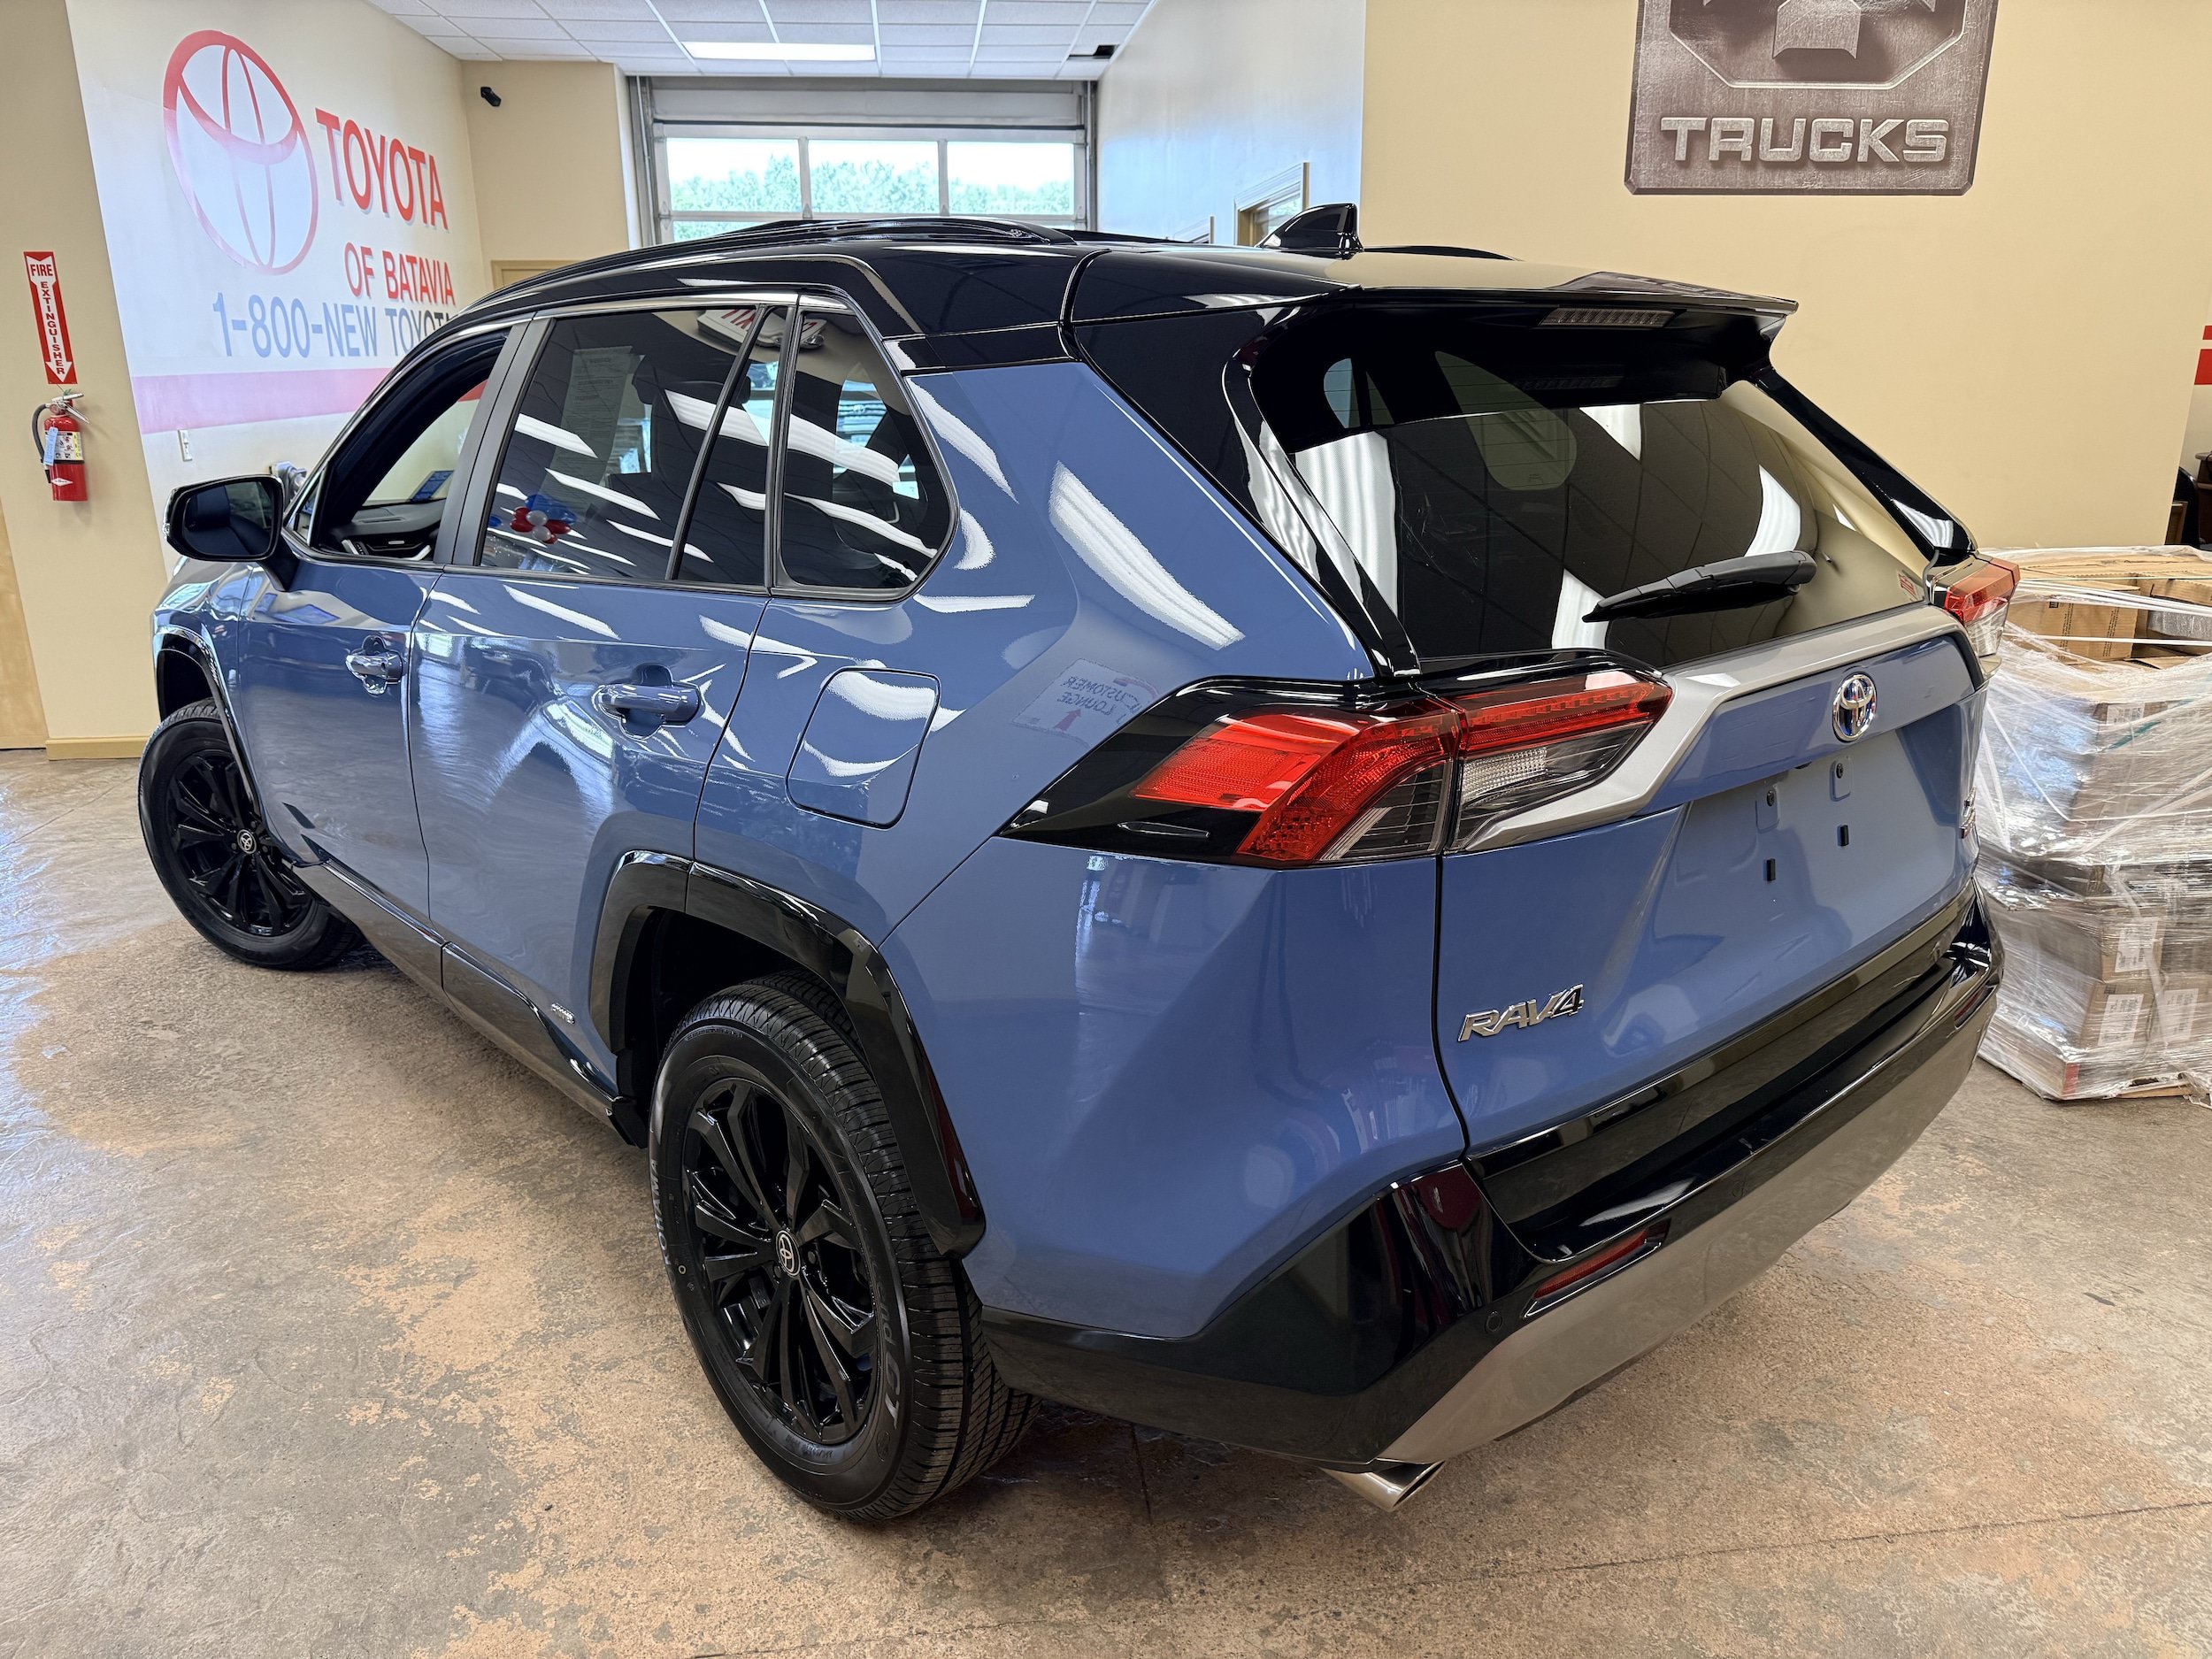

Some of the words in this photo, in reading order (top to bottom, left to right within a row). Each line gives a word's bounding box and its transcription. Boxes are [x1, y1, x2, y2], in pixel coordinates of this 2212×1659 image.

[315, 108, 449, 230] TOYOTA
[1661, 117, 1949, 163] TRUCKS
[29, 264, 53, 277] FIRE
[344, 242, 375, 298] OF
[382, 250, 457, 307] BATAVIA
[40, 281, 65, 375] EXTINGUISHER
[212, 292, 378, 358] 1-800-NEW
[384, 307, 451, 357] TOYOT
[1457, 983, 1585, 1042] RAV4
